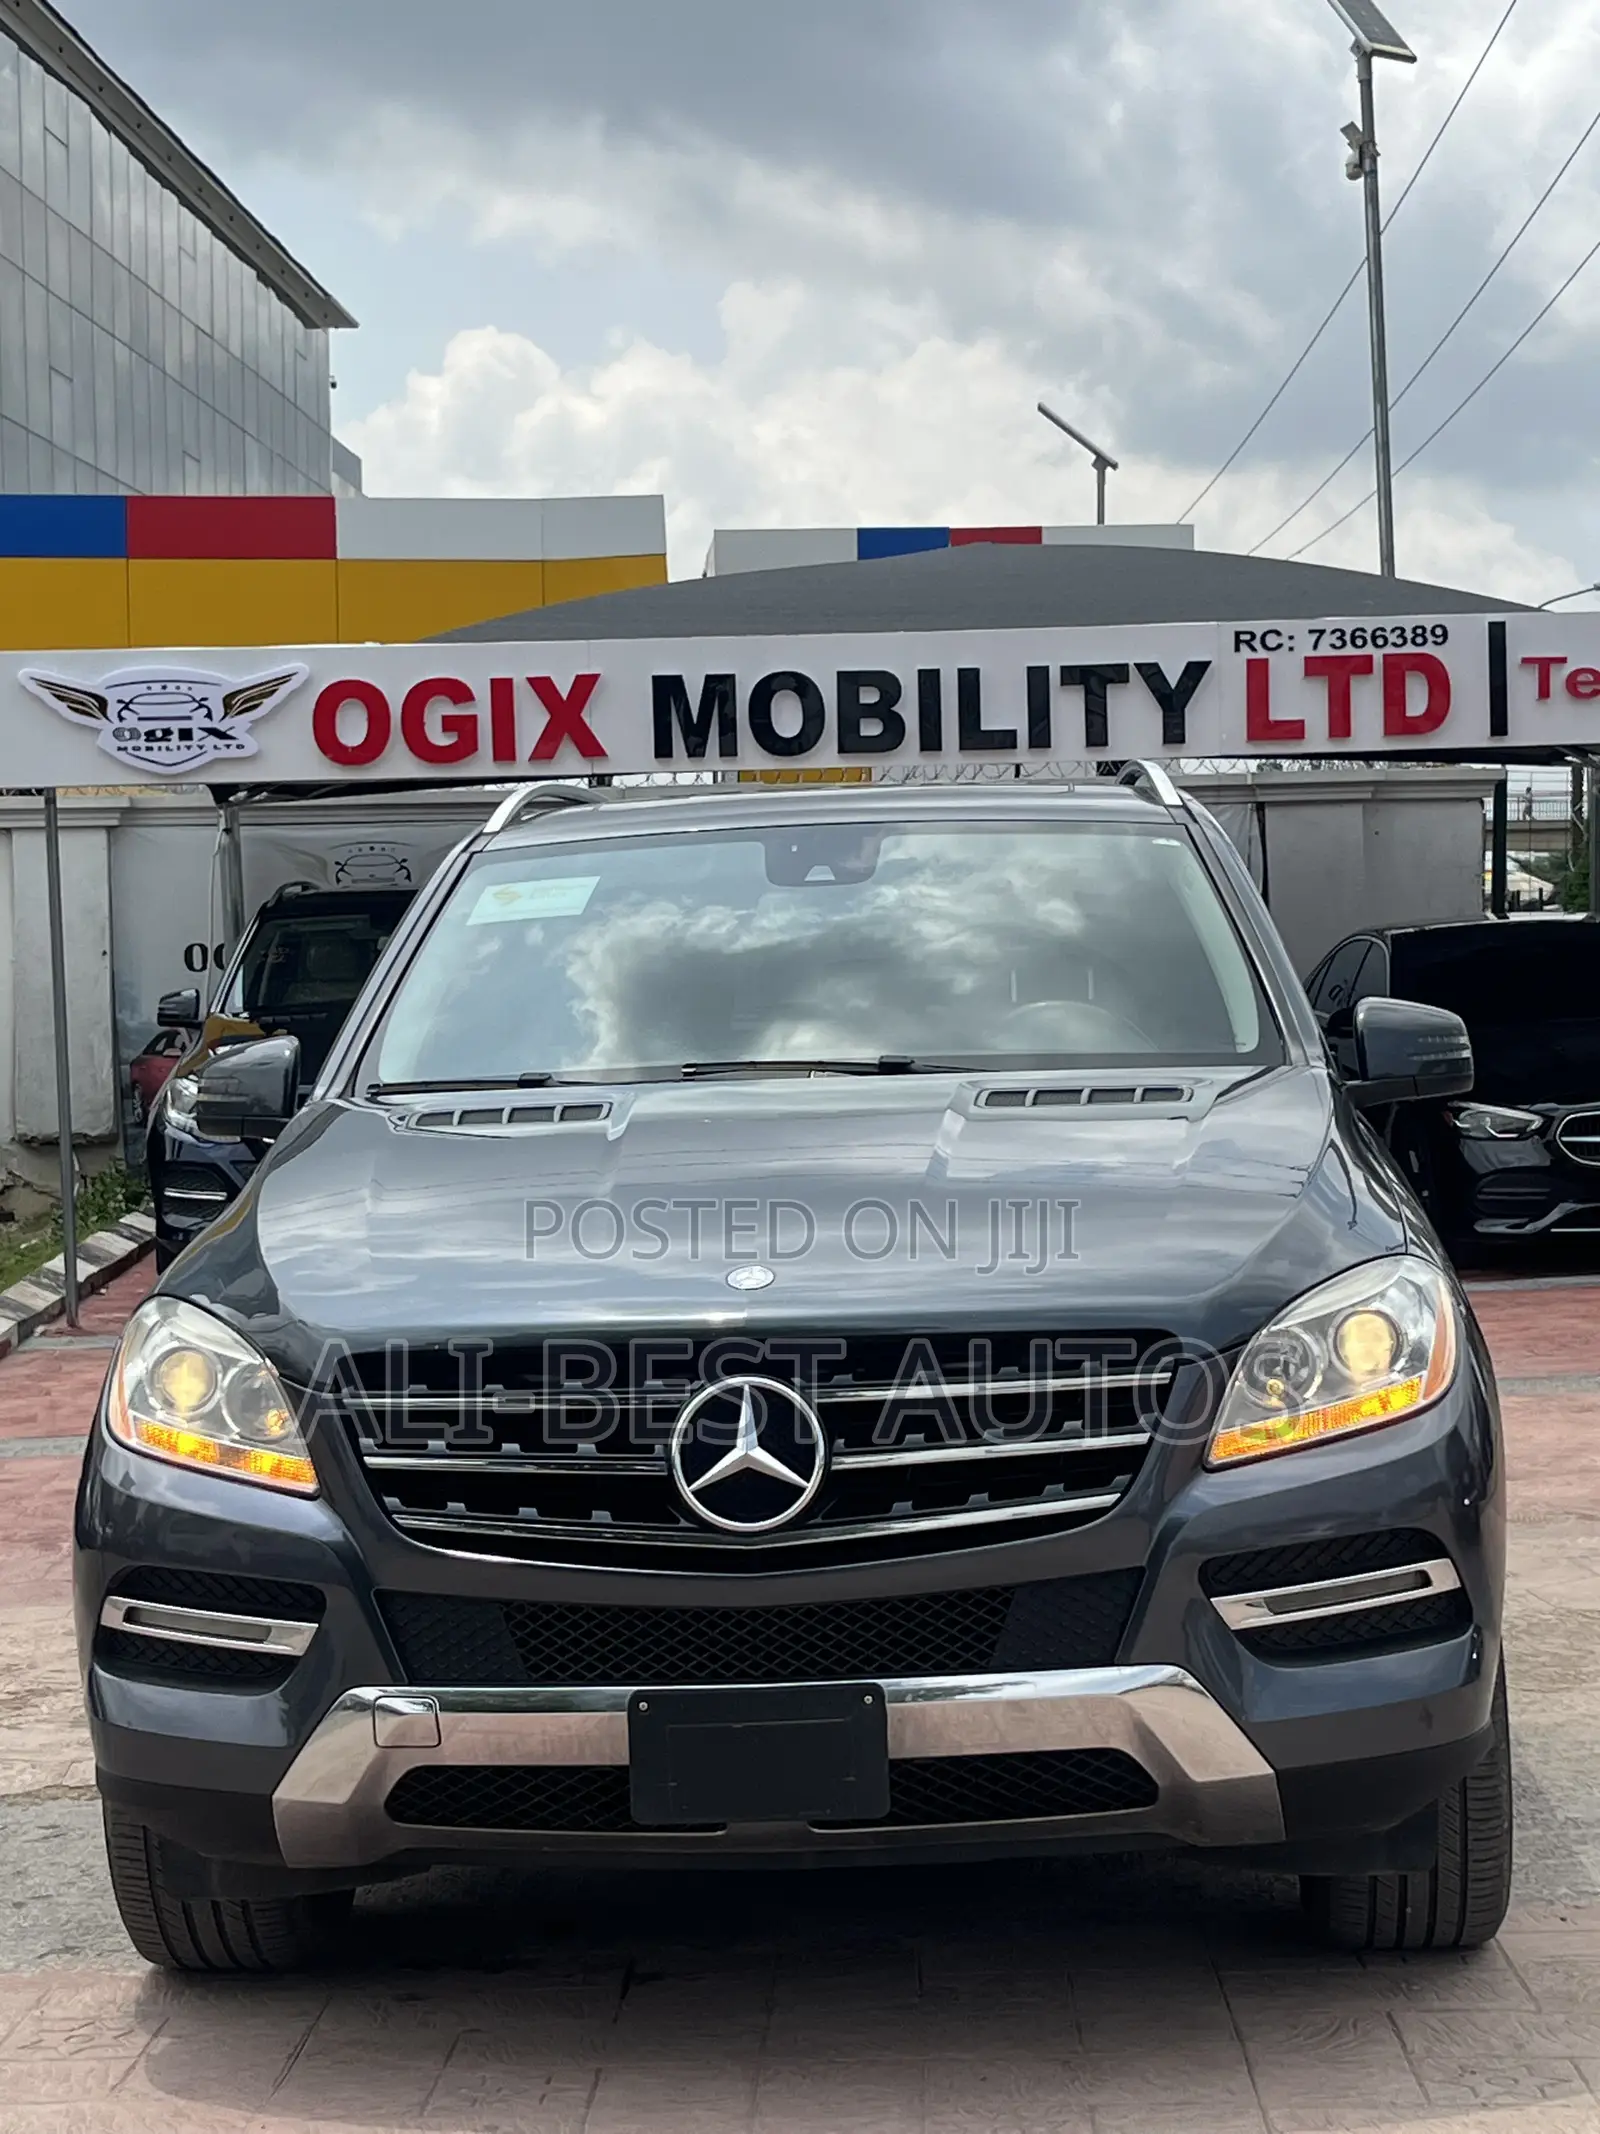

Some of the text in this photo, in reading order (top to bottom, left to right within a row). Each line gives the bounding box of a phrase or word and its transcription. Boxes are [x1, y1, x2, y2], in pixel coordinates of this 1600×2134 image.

[1233, 624, 1449, 652] RC: 7366389
[312, 652, 1451, 767] OGIX MOBILITY LTD
[116, 744, 206, 752] MOBILITY
